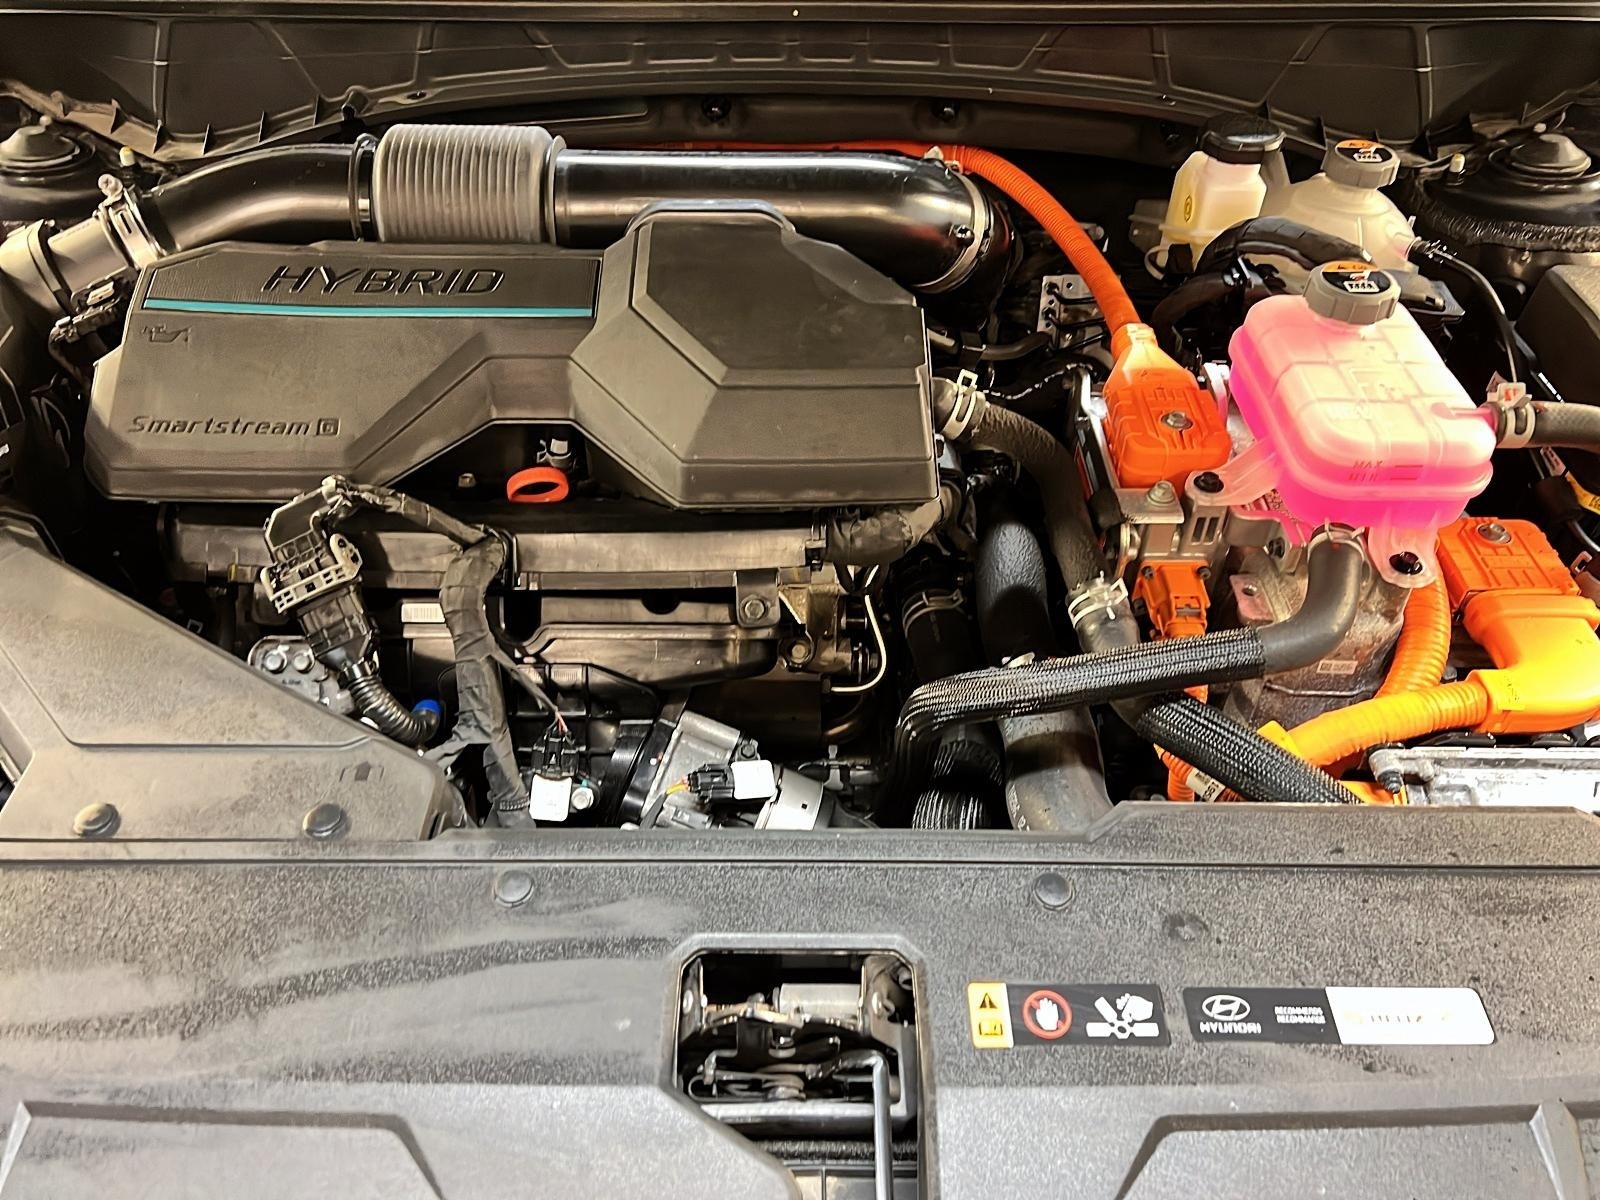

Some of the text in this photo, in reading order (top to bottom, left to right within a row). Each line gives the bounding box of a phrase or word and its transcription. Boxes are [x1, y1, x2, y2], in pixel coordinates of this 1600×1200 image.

[261, 265, 505, 295] HYBRID
[129, 415, 311, 436] Smartstream
[1199, 1021, 1262, 1034] HYUNDAI
